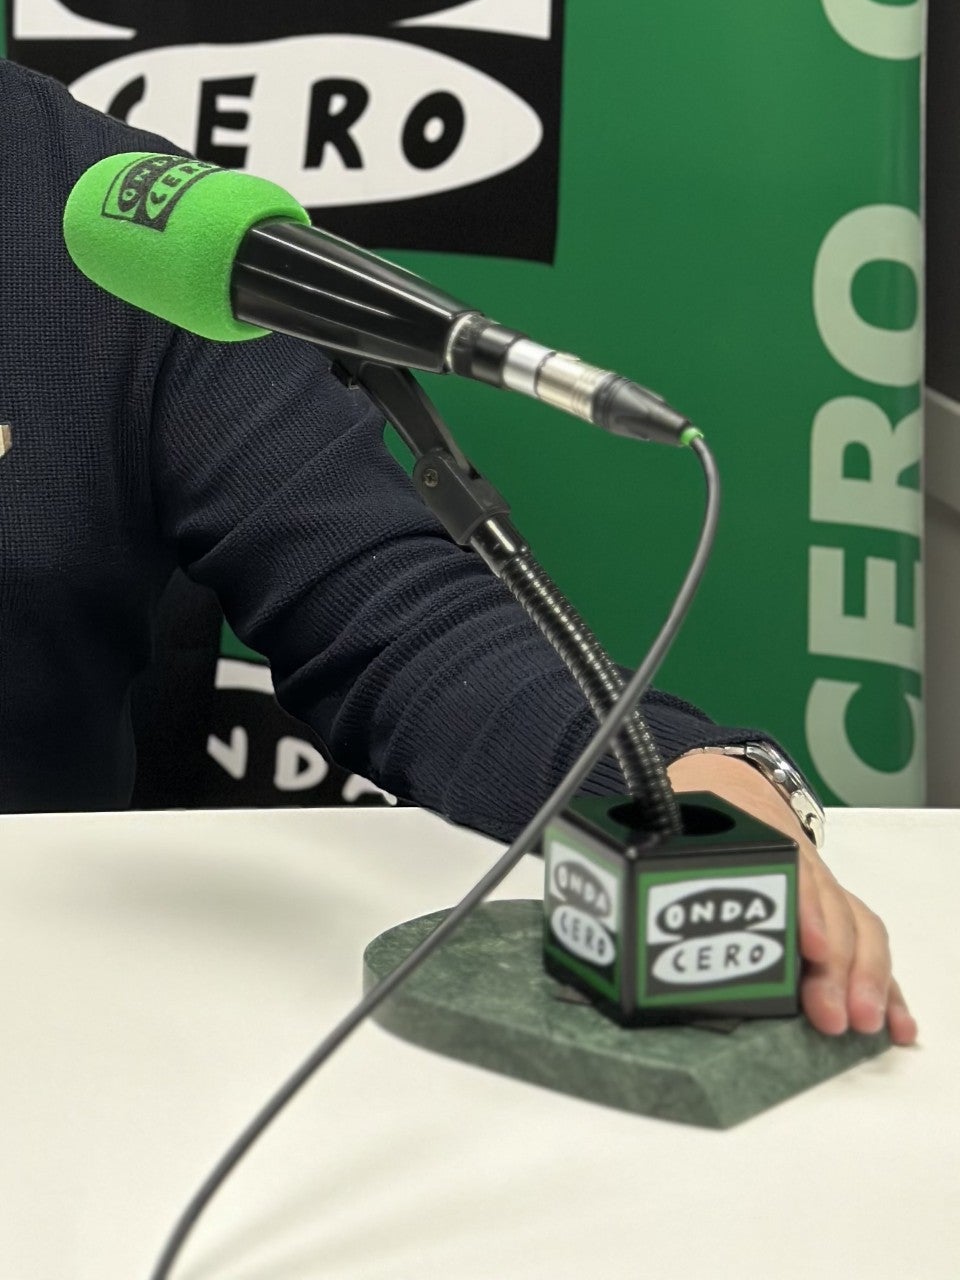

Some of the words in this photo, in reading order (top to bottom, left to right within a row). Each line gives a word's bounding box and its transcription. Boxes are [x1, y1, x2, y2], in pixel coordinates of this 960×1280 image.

[804, 204, 925, 808] CERO
[665, 898, 767, 930] ONDA
[672, 943, 766, 974] CERO
